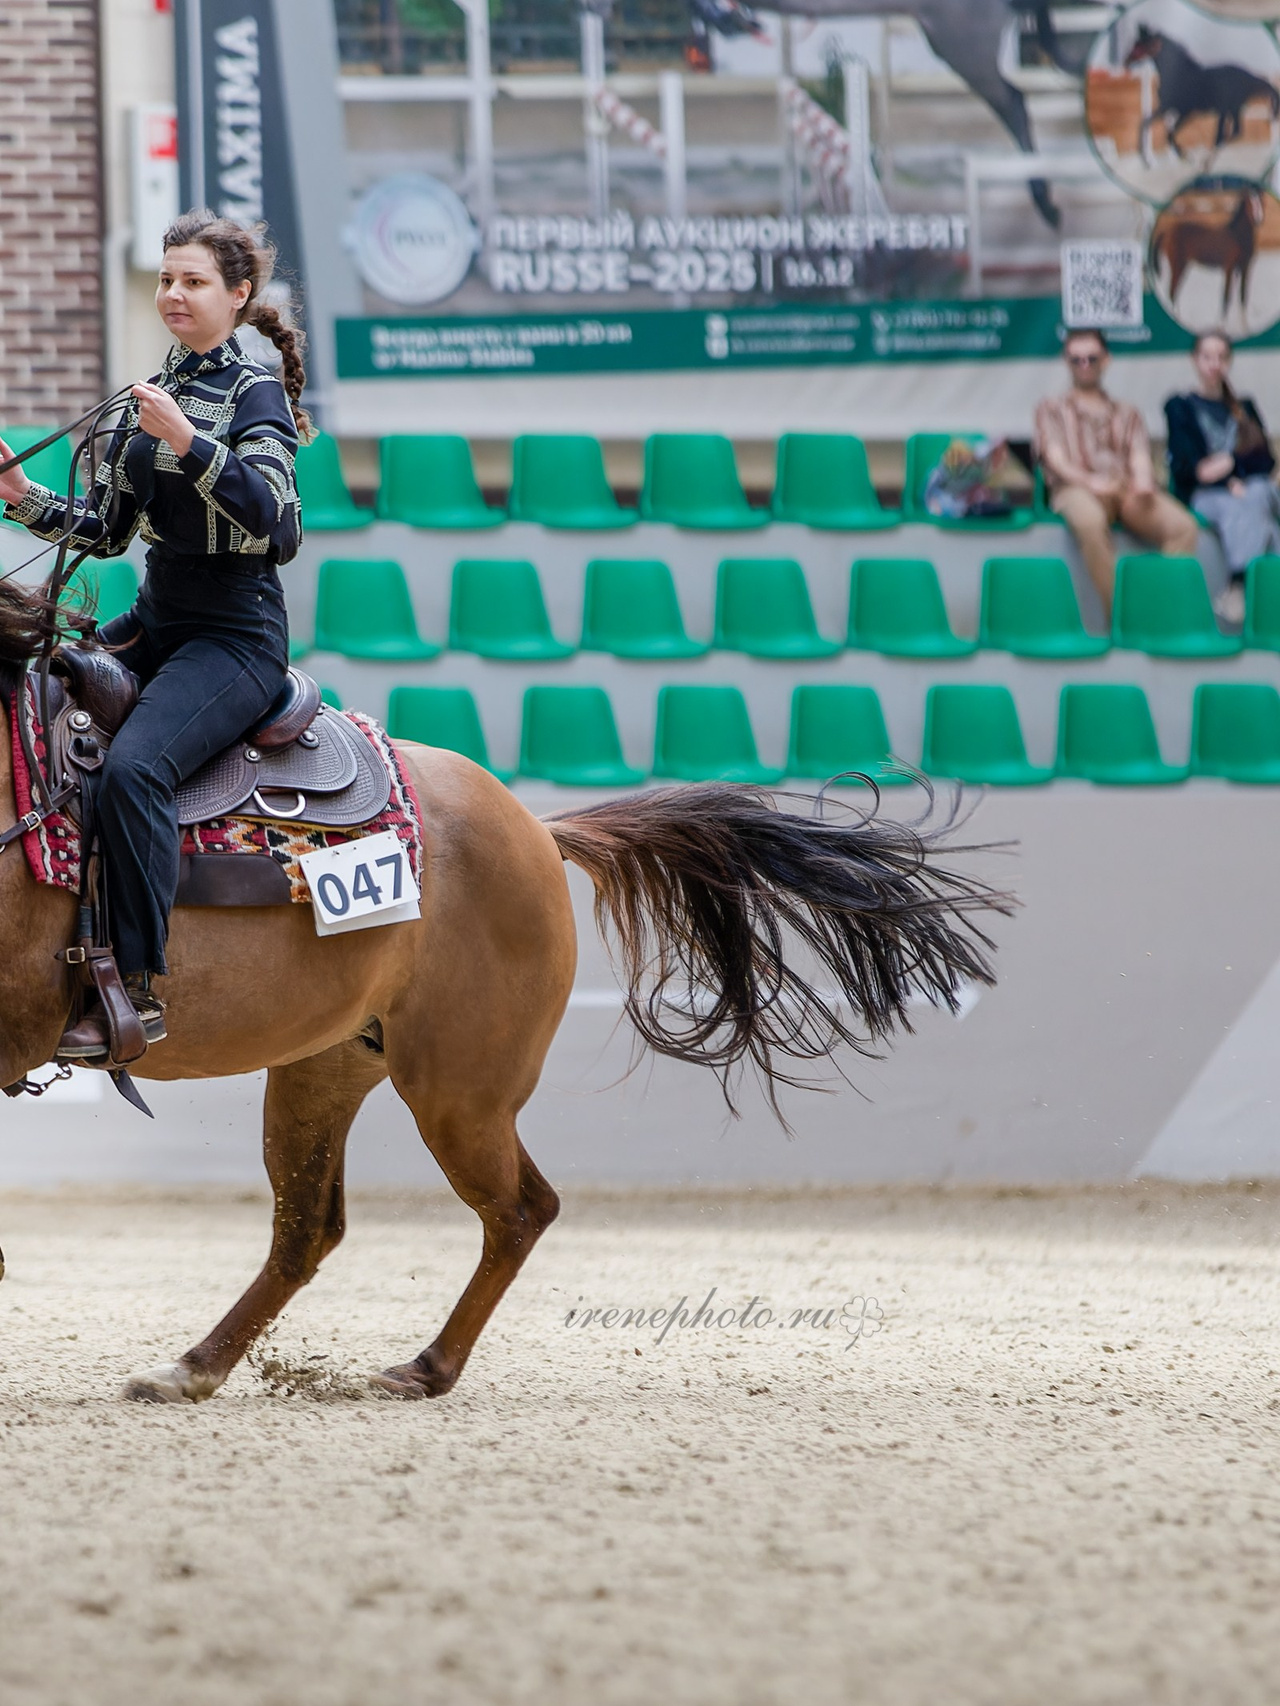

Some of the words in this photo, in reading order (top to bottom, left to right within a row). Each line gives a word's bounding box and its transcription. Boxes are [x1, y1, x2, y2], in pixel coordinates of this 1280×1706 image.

[489, 208, 635, 249] ПЕРВЫЙ
[639, 214, 805, 251] АУКЦИОН
[807, 213, 968, 250] ЖЕРЕБЯТ
[317, 852, 403, 917] 047
